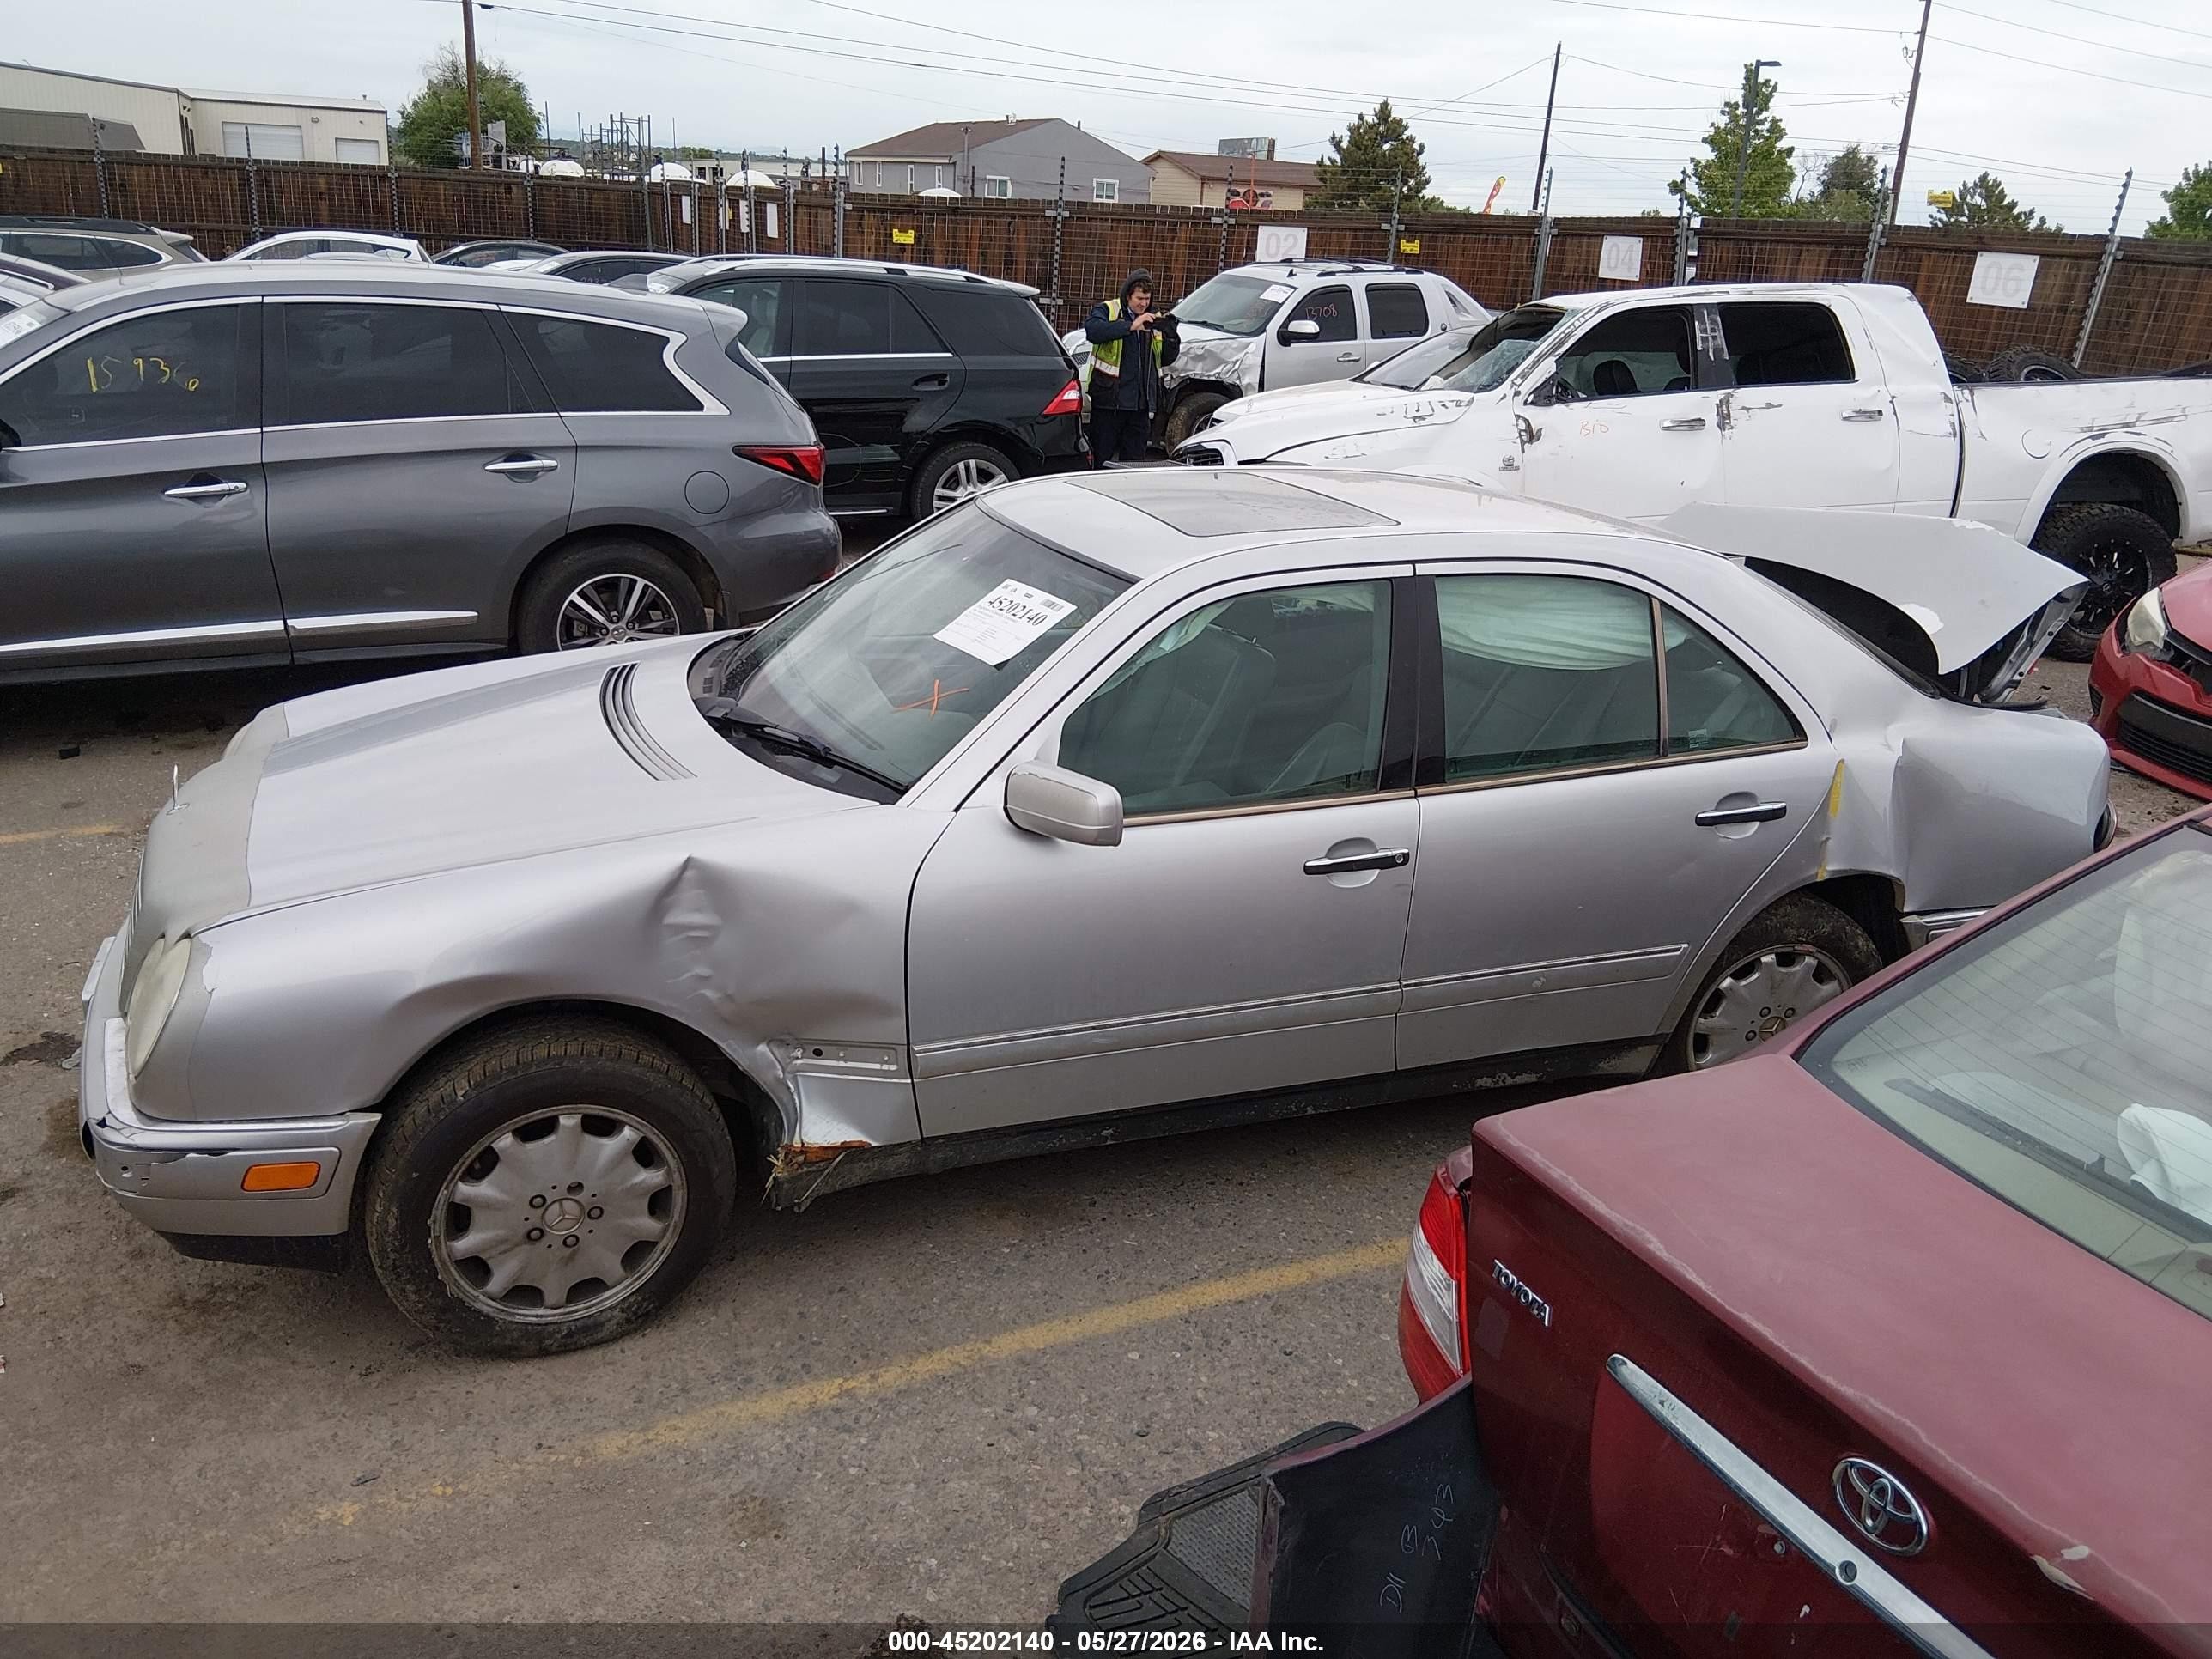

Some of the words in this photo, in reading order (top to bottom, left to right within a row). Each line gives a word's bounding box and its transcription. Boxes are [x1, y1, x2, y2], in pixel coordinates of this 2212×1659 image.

[1265, 233, 1299, 258] 02
[1607, 242, 1634, 272] 04
[1981, 261, 2025, 297] 06
[988, 596, 1048, 626] 45202140
[1492, 1258, 1553, 1328] TOYOTA
